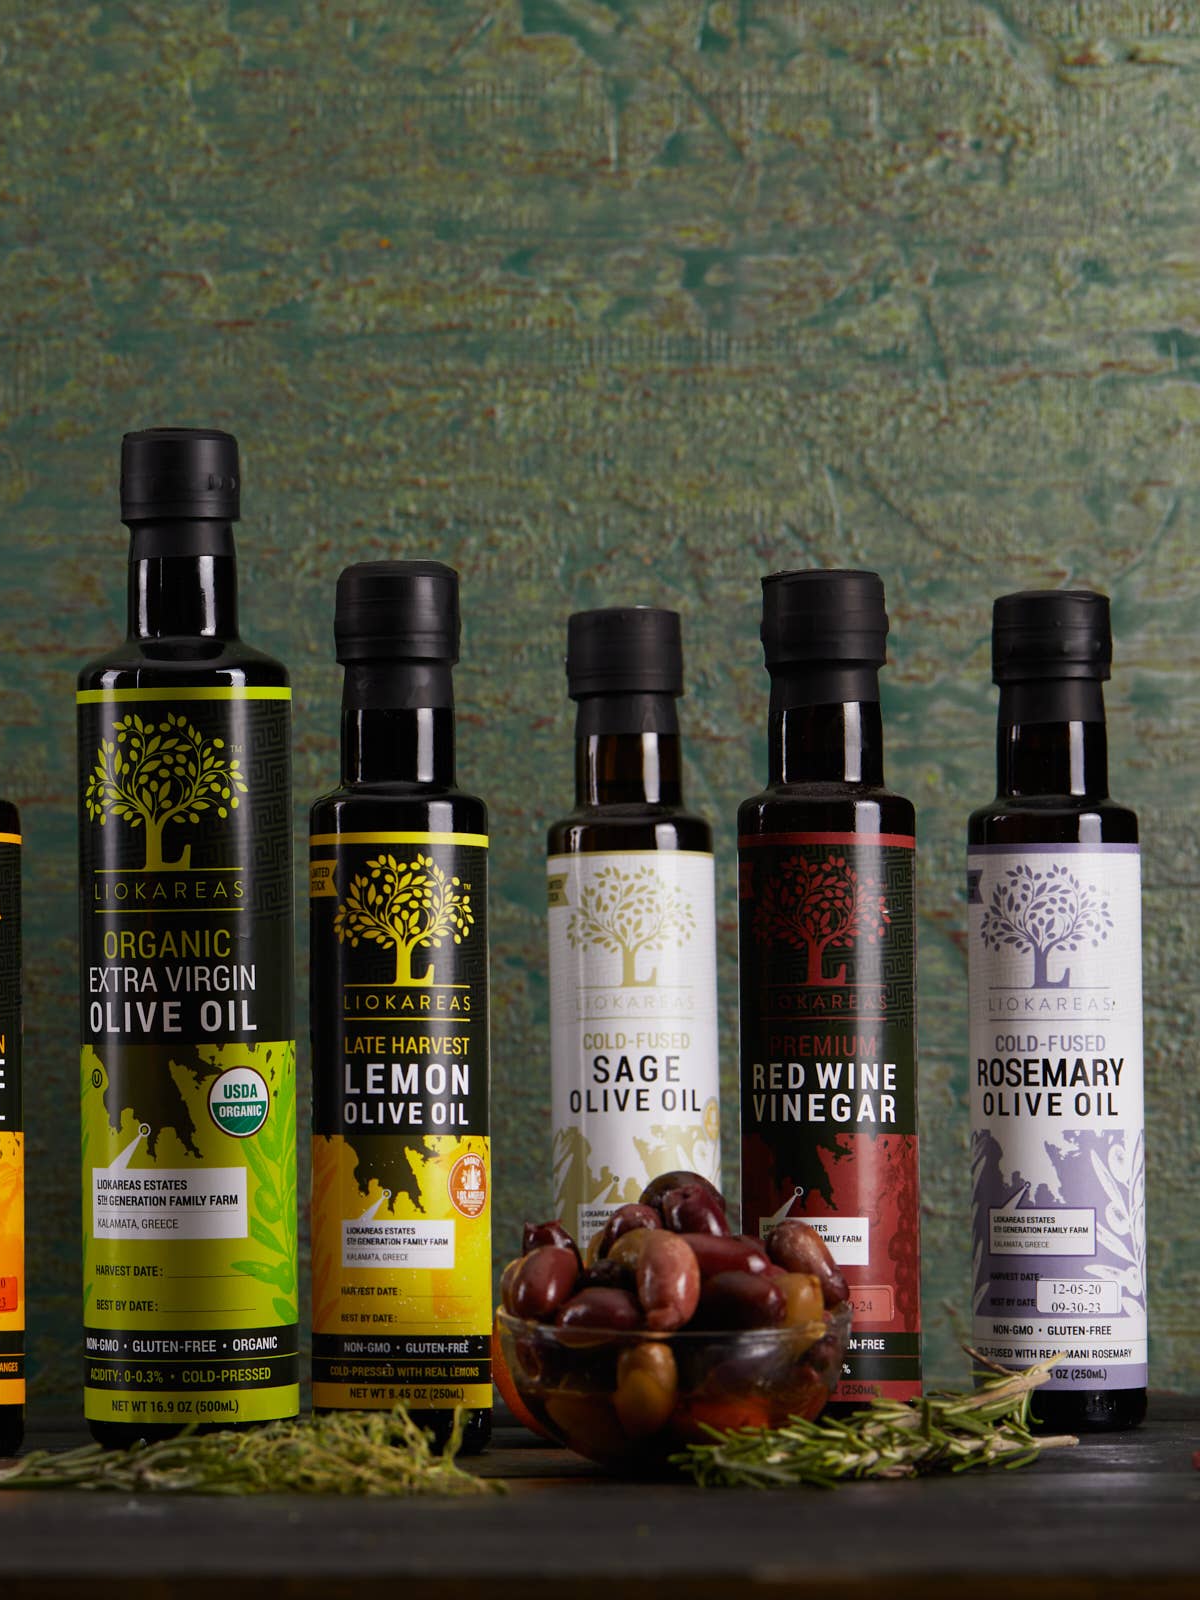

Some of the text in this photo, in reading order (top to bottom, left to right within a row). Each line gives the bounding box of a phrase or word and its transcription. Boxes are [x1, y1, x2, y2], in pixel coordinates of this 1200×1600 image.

[95, 880, 243, 900] LIOKAREAS
[104, 929, 231, 959] ORGANIC
[90, 964, 256, 993] EXTRA VIRGIN
[344, 994, 470, 1010] LIOKAREAS
[989, 997, 1111, 1012] LIOKAREAS
[90, 1000, 257, 1033] OLIVE OIL
[345, 1036, 469, 1054] LATE HARVEST
[584, 1033, 690, 1049] COLD-FUSED
[770, 1036, 877, 1056] PREMIUM
[996, 1035, 1106, 1052] COLD-FUSED
[593, 1055, 680, 1083] SAGE
[978, 1058, 1124, 1087] ROSEMARY
[345, 1064, 469, 1096] LEMON
[753, 1064, 896, 1090] RED WINE
[224, 1084, 258, 1098] USDA
[570, 1089, 701, 1113] OLIVE OIL
[753, 1094, 896, 1122] VINEGAR
[983, 1092, 1118, 1116] OLIVE OIL
[219, 1105, 262, 1117] ORGANIC
[344, 1102, 469, 1125] OLIVE OIL
[97, 1180, 187, 1190] LIOKAREAS ESTATES
[109, 1195, 238, 1206] GENERATION FAMILY FARM
[98, 1219, 178, 1230] KALAMATA, GREECE
[385, 1227, 416, 1235] ESTATES
[1003, 1226, 1042, 1234] GENERATION
[1044, 1226, 1068, 1234] FAMILY
[358, 1238, 449, 1246] GENERATION FAMILY FARM
[96, 1265, 131, 1276] HARVEST
[1053, 1284, 1101, 1295] 12-05-20
[97, 1300, 127, 1311] BEST BY
[1051, 1303, 1100, 1313] 09-30-23
[360, 1314, 370, 1322] BY
[993, 1325, 1111, 1335] NON-GMO GLUTEN-FREE
[87, 1337, 277, 1353] NON-GMO GLUTEN-FREE ORGANIC
[344, 1342, 469, 1353] NON-GMO GLUTEN-FREE
[1015, 1348, 1132, 1358] WITH ROSEMARY
[91, 1368, 271, 1383] ACIDITY: 0-0.3% COLD-PRESSED
[397, 1367, 479, 1376] WITH REAL LEMONS
[1056, 1369, 1069, 1379] OZ
[350, 1389, 427, 1399] NET WT OZ
[112, 1401, 192, 1412] NET WT 16.9 OZ
